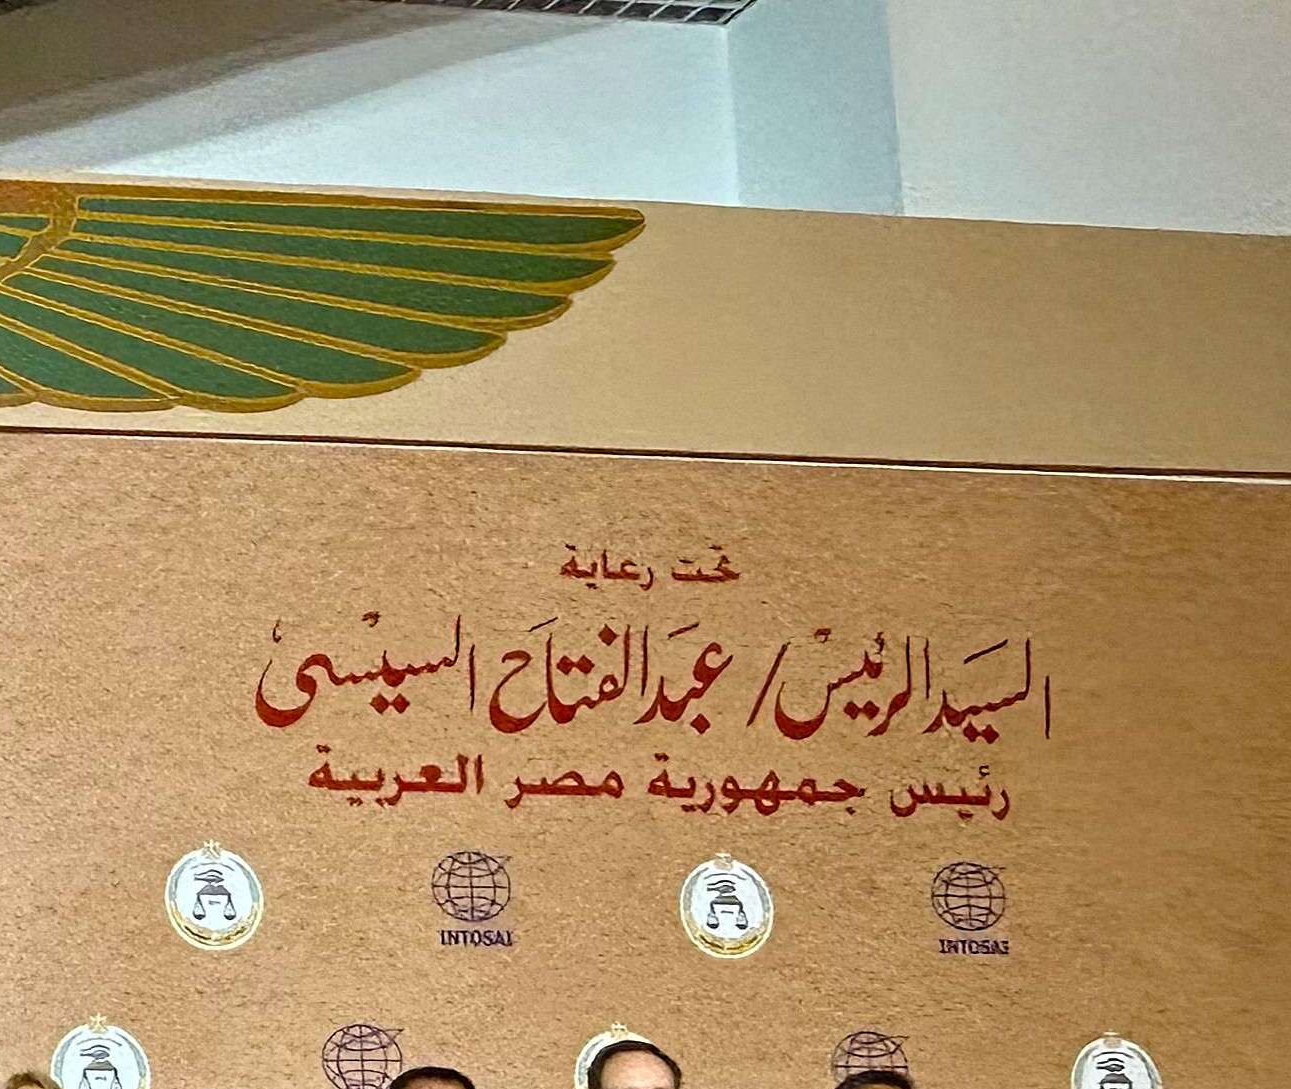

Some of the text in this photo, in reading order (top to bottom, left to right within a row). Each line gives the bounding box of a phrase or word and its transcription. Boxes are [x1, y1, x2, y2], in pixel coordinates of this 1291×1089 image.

[558, 542, 742, 592] تحت رعاية
[307, 743, 1012, 821] رئيس جمهورية مصر العربية
[437, 929, 513, 947] INTOSAI
